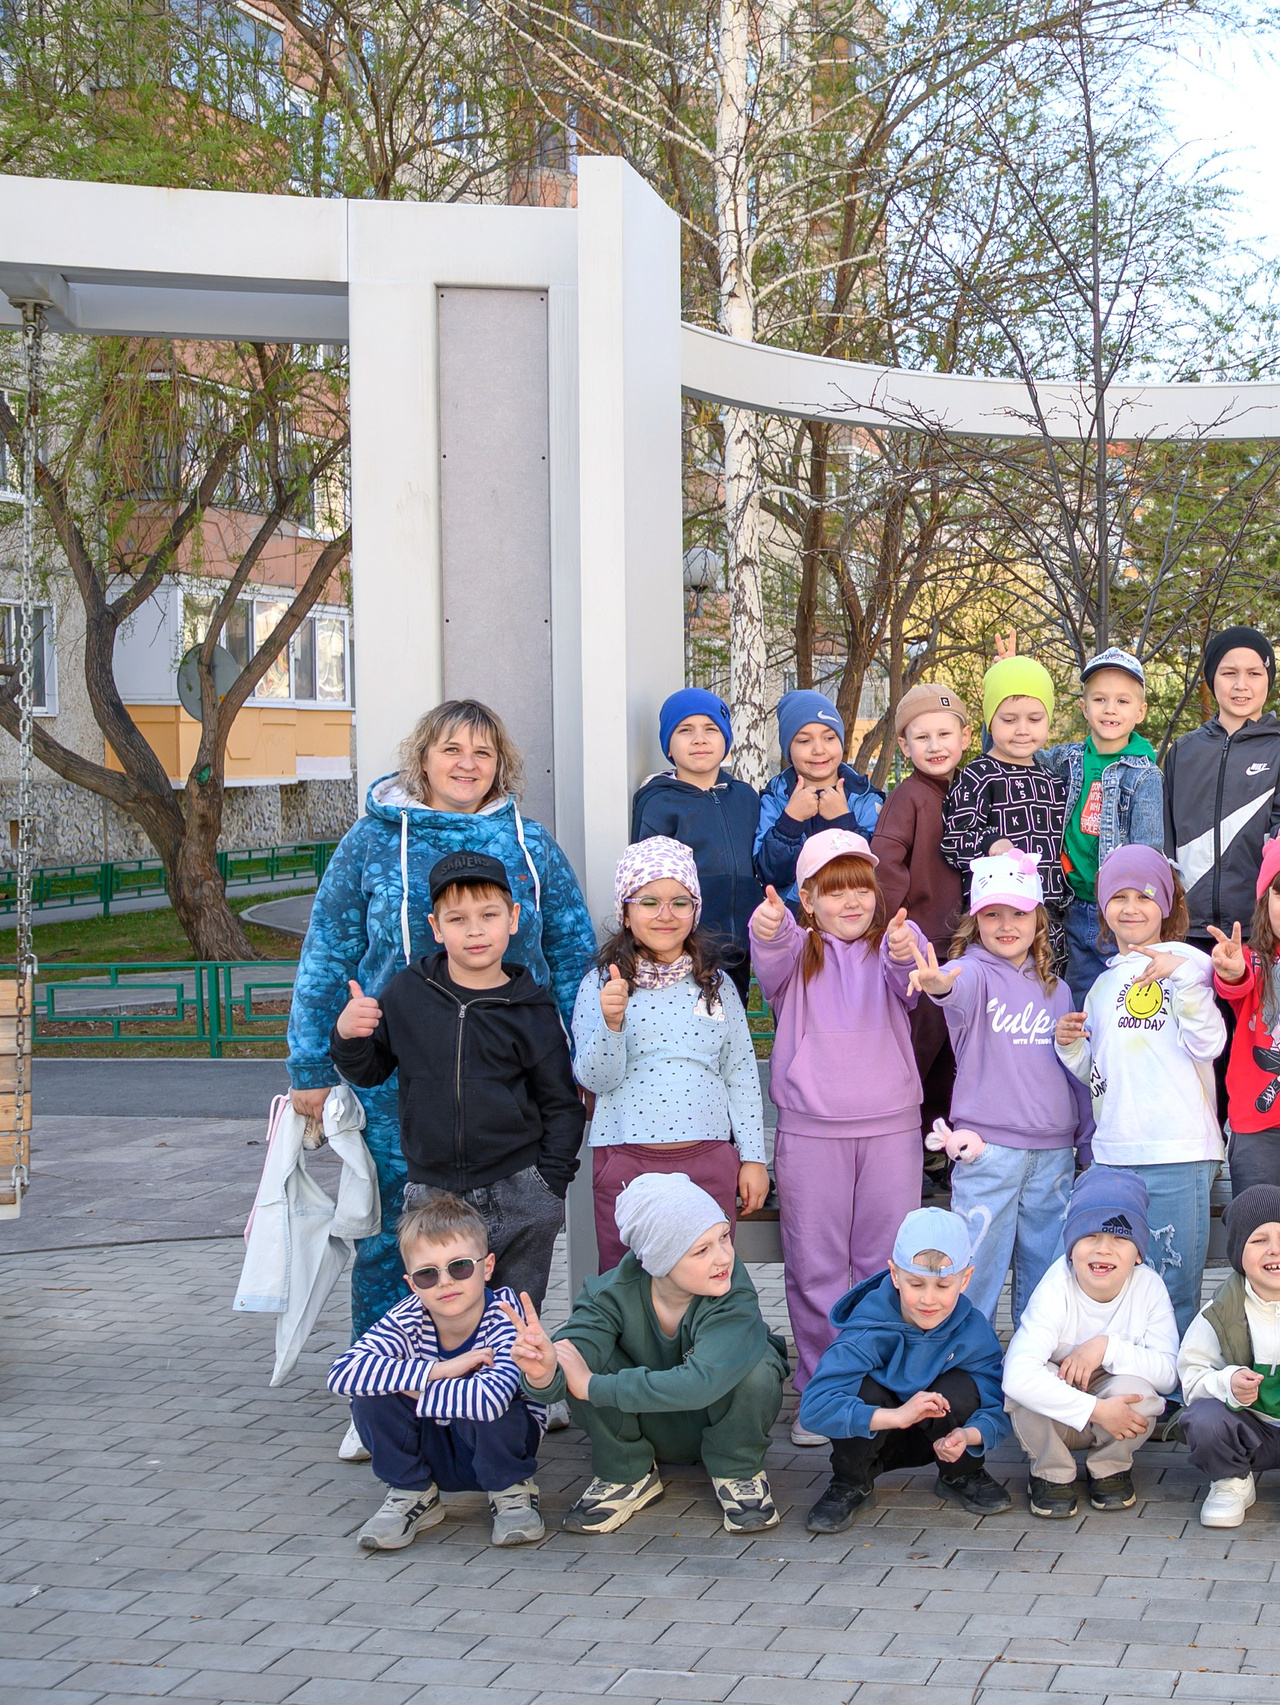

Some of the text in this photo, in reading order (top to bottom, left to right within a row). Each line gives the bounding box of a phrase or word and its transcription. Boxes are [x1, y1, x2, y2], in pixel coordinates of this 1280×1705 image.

[1011, 816, 1019, 826] K
[1036, 815, 1041, 824] E
[1118, 1016, 1166, 1031] GOOD DAY
